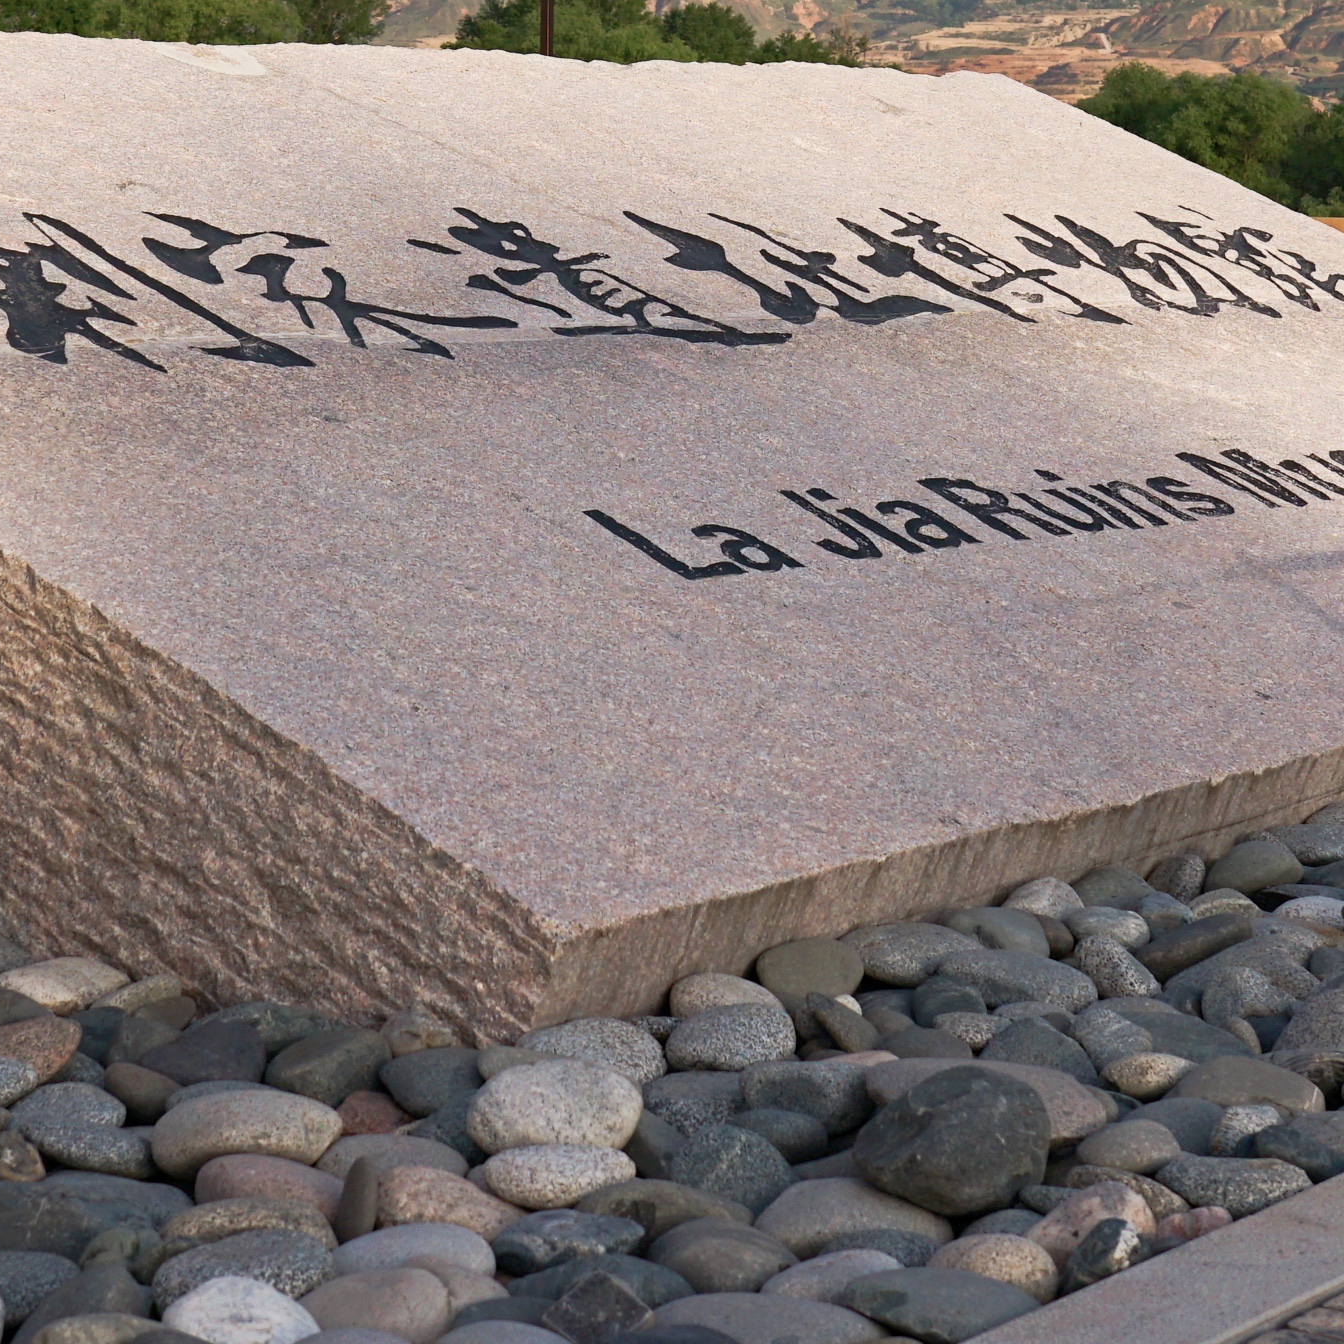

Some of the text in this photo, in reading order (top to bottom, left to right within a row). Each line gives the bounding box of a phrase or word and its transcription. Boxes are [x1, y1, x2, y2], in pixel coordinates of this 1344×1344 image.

[582, 509, 805, 580] La
[779, 487, 981, 559] Jia
[918, 469, 1235, 540] Ruins
